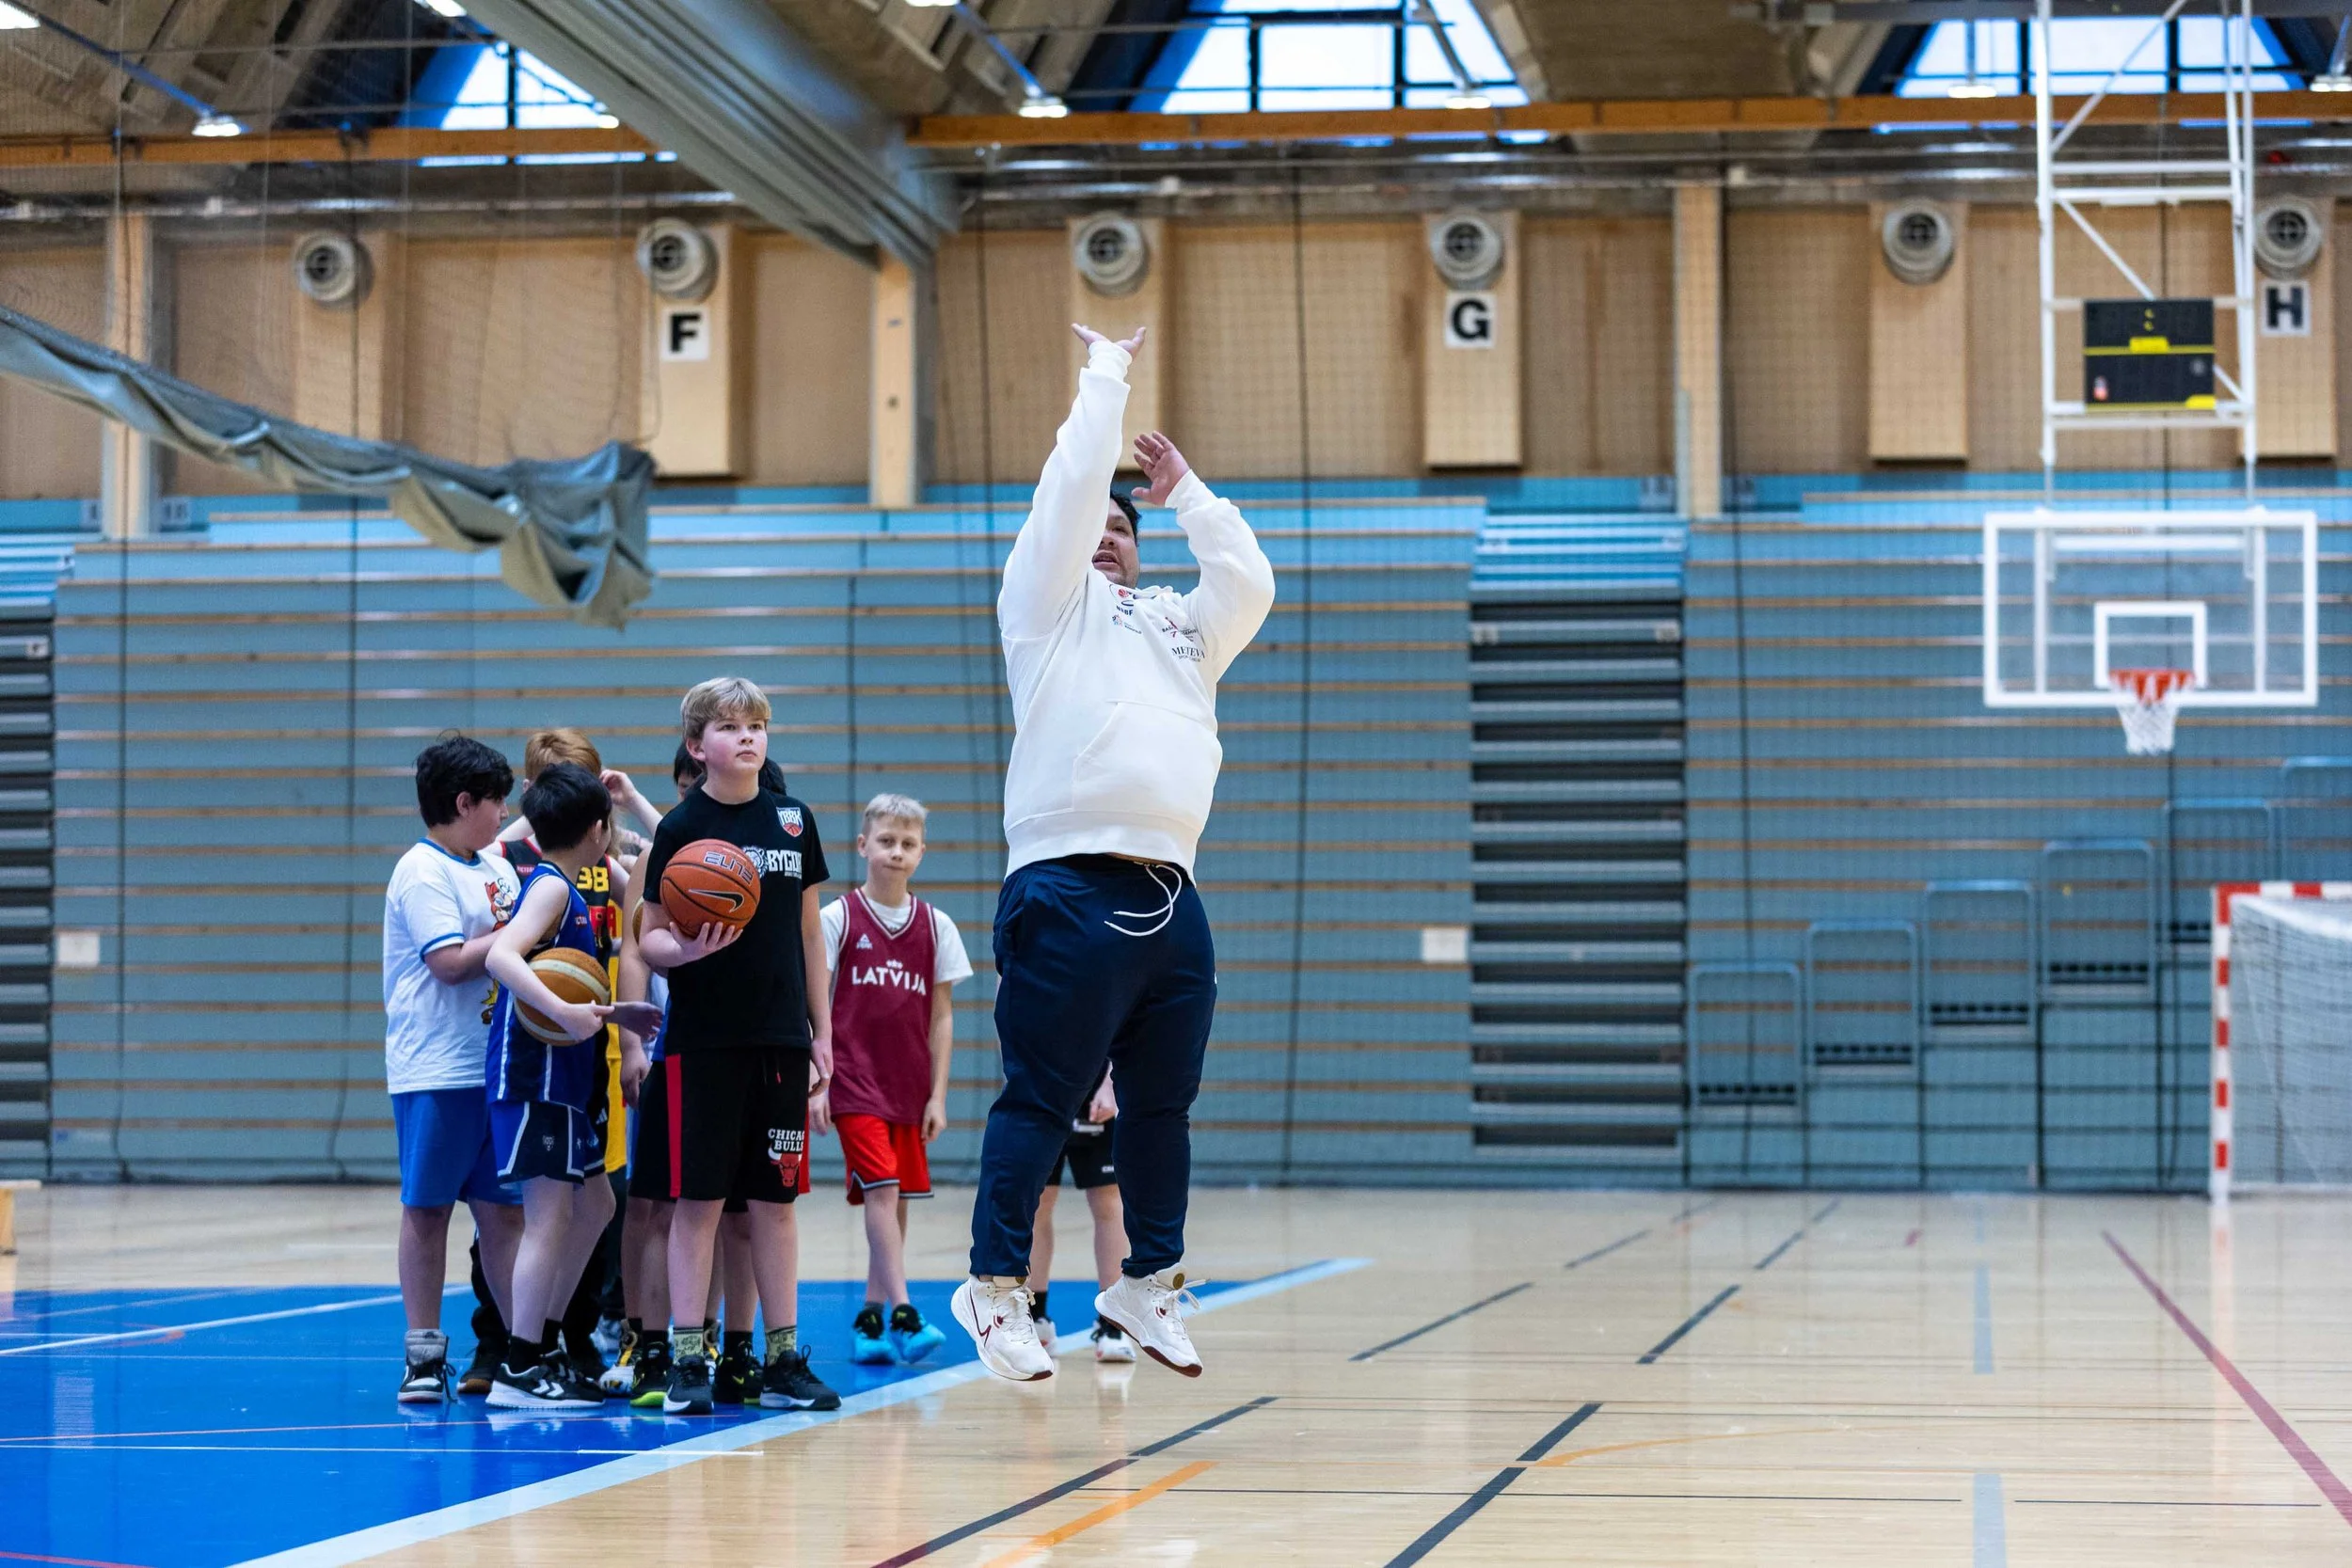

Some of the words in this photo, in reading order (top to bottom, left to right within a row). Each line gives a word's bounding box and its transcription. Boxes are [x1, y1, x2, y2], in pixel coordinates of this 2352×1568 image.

[1452, 298, 1489, 341] G
[2265, 286, 2304, 328] H
[670, 312, 702, 354] F
[577, 866, 610, 892] 38
[704, 850, 754, 886] ELITE
[851, 965, 927, 996] LATVIJA
